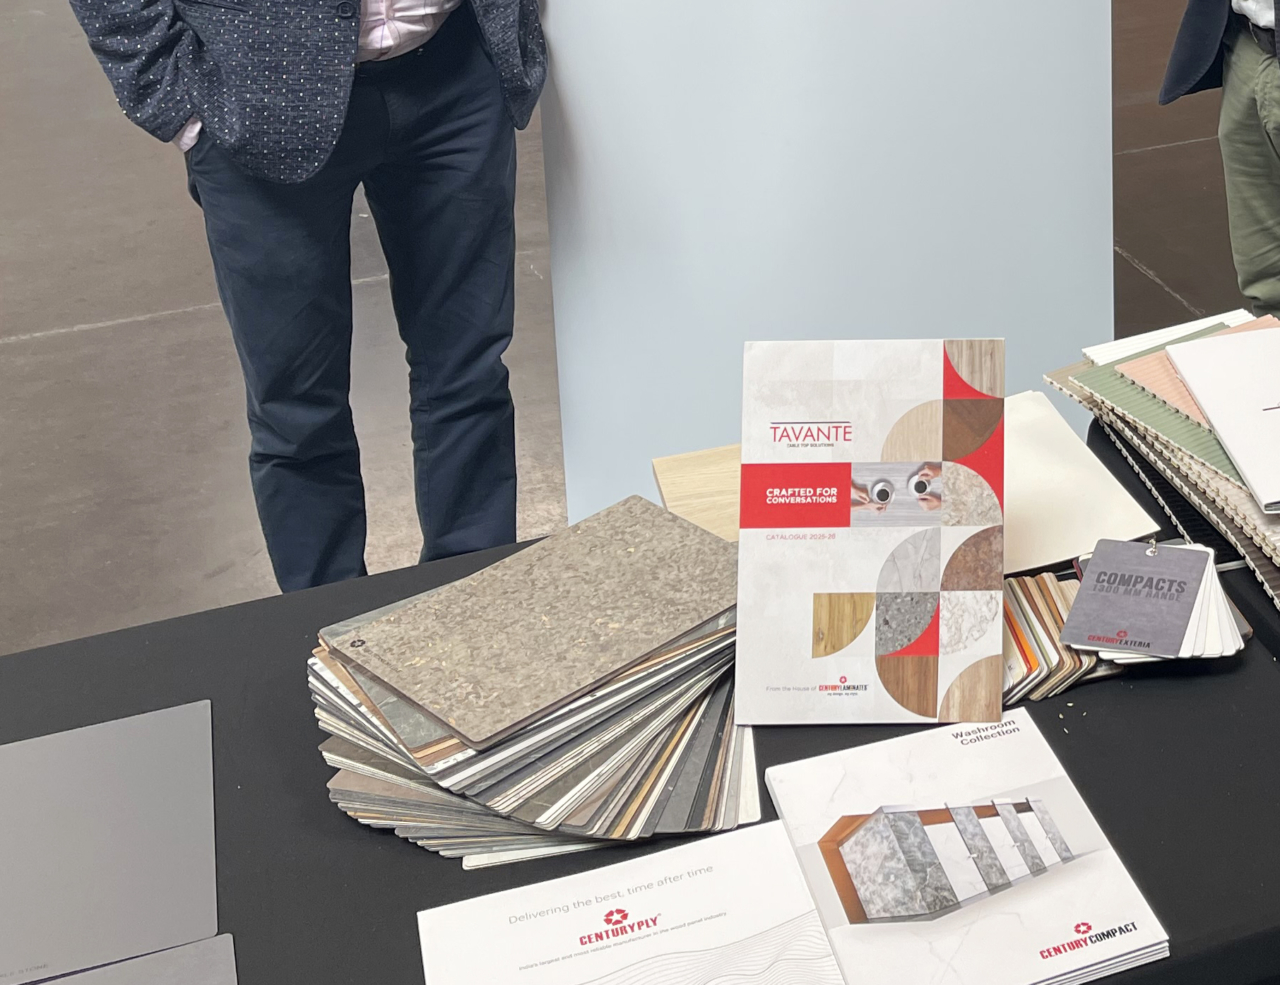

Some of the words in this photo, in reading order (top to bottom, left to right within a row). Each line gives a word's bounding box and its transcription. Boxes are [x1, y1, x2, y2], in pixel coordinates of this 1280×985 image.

[770, 425, 852, 442] TAVANTE
[766, 488, 814, 497] CRAFTED
[816, 488, 838, 496] FOR
[766, 496, 838, 504] CONVERSATIONS
[1095, 571, 1187, 594] COMPACTS
[1092, 583, 1120, 594] 1300
[1123, 587, 1143, 597] MM
[1145, 590, 1182, 602] RANGE
[951, 719, 1016, 740] Washroom
[960, 726, 1021, 746] Collection
[508, 905, 570, 925] Delivering
[573, 899, 592, 909] the
[595, 890, 624, 904] best,
[627, 882, 654, 895] time
[657, 873, 684, 887] after
[687, 865, 714, 878] time
